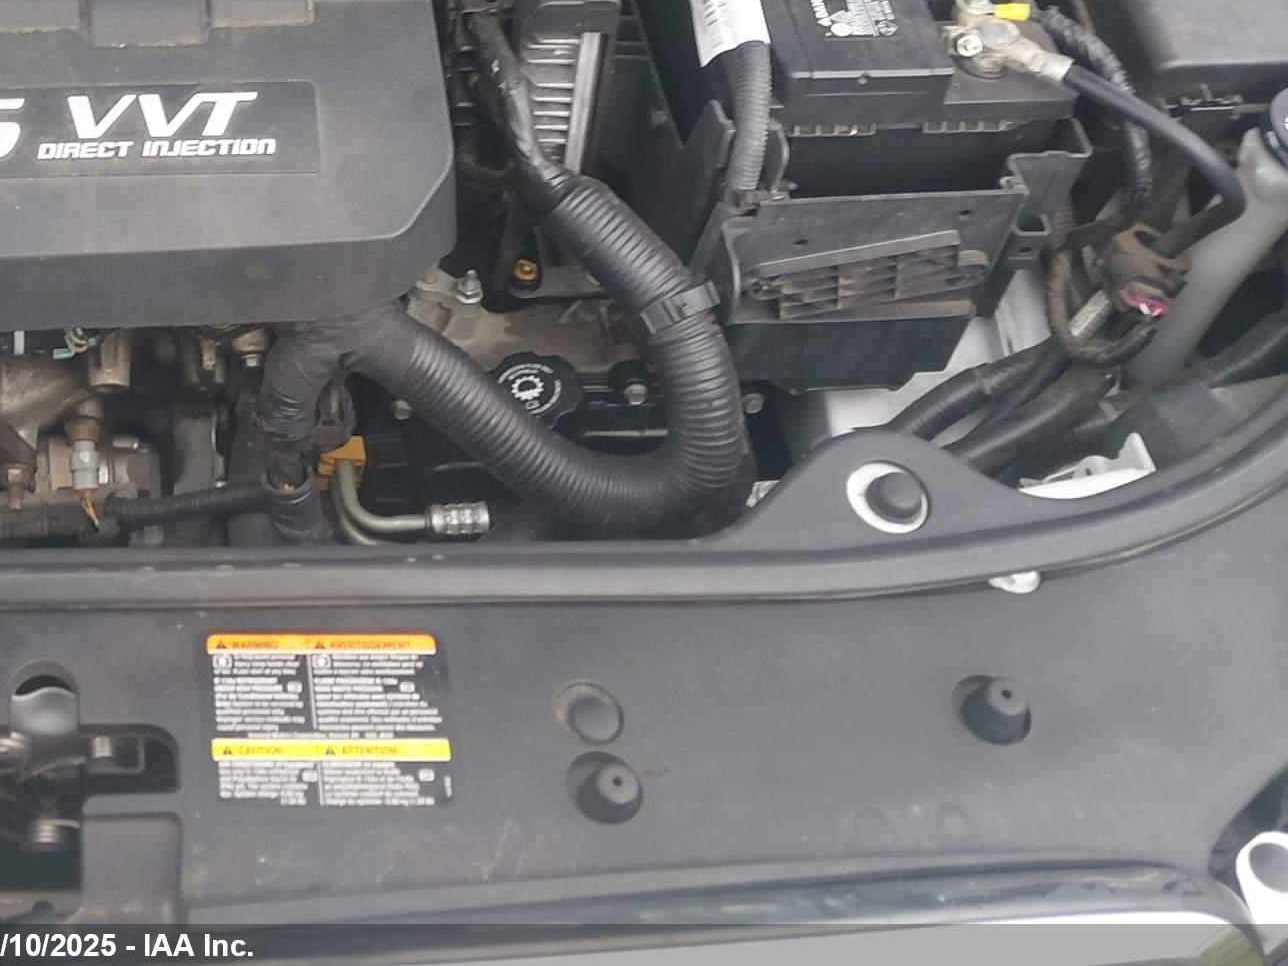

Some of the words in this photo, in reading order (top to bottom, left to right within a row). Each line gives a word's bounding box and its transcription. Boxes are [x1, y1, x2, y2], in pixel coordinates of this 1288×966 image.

[67, 91, 258, 138] VVT
[37, 140, 134, 161] DIRECT
[142, 138, 277, 159] INJECTION
